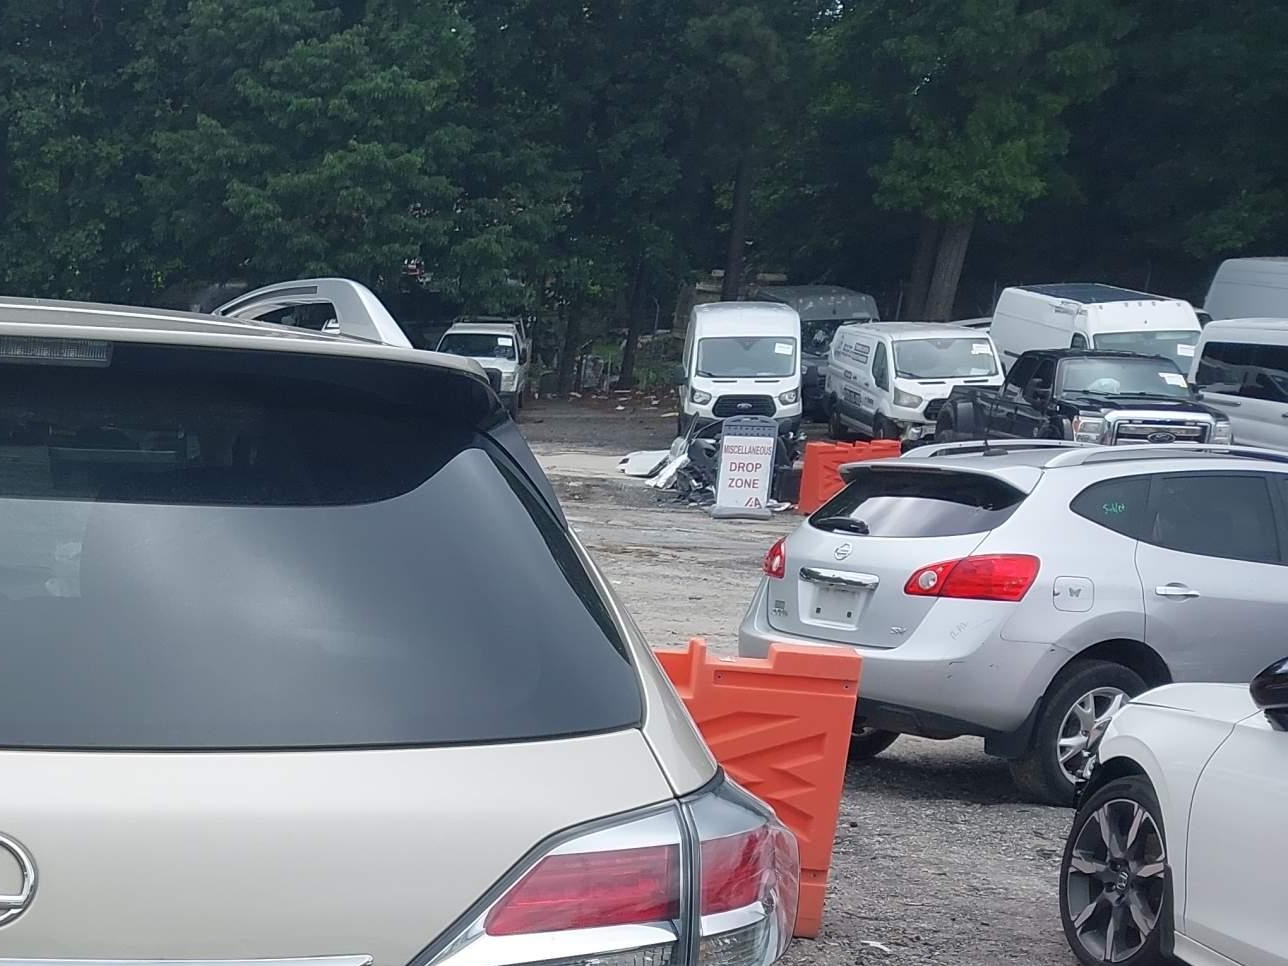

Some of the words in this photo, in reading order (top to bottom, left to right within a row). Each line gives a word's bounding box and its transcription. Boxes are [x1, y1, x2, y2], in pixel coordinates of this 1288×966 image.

[724, 444, 773, 456] MISCELLANEOUS
[729, 461, 762, 473] DROP
[727, 477, 760, 489] ZONE
